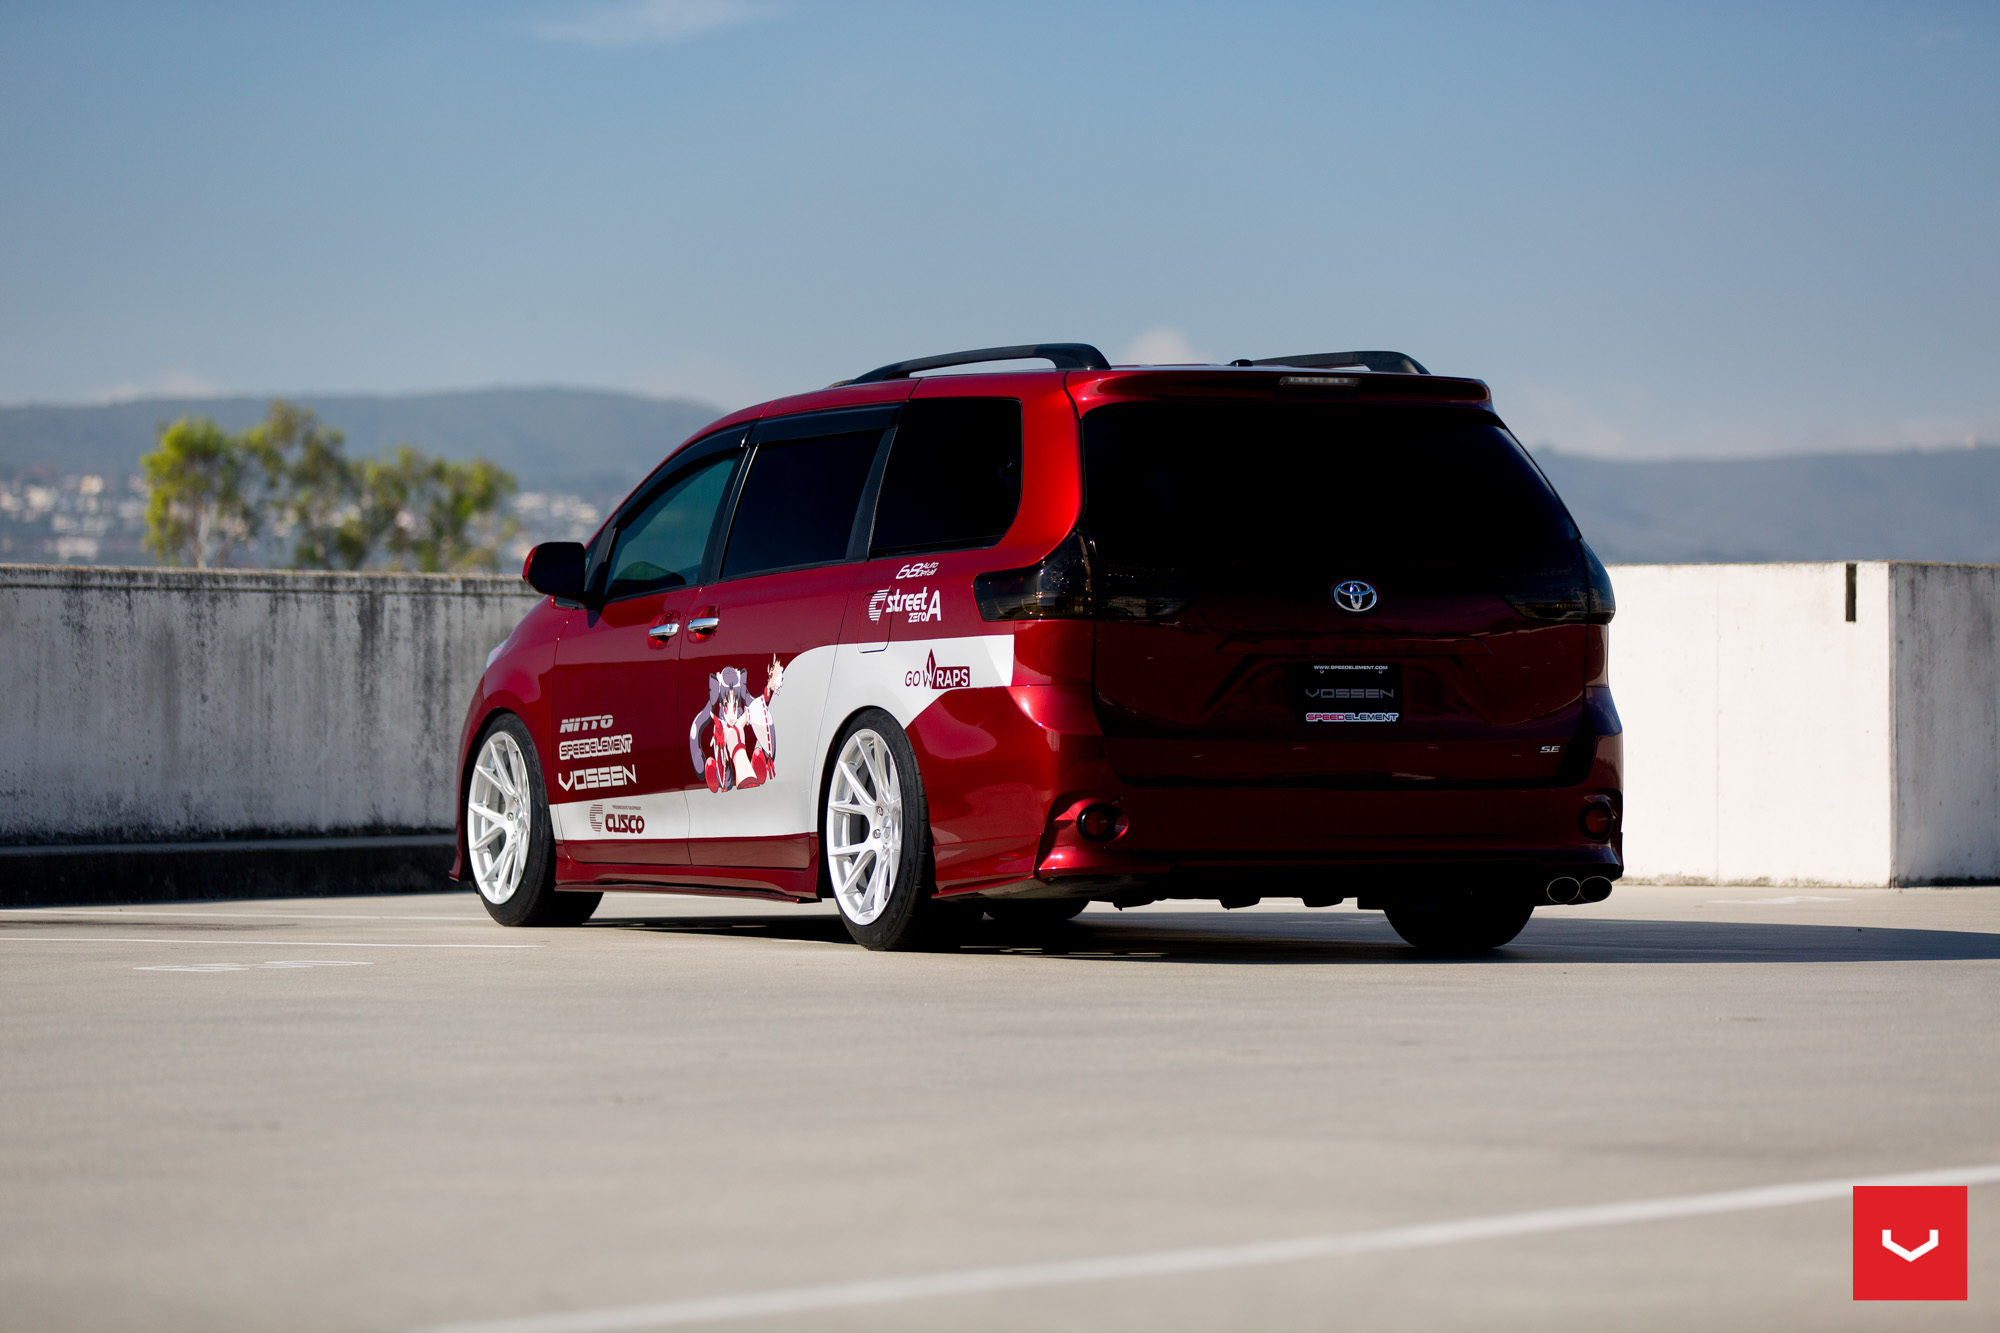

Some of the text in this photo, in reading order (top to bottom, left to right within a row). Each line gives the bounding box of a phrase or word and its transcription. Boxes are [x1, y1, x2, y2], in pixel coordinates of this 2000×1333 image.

[896, 563, 924, 579] 68
[886, 587, 942, 622] street A
[904, 649, 970, 689] GO WRAPS
[1305, 689, 1394, 699] VOSSEN
[560, 715, 613, 733] NITTO
[1306, 713, 1399, 722] SPEEDELEMENT
[559, 734, 633, 760] SPEEDELEMENT
[558, 764, 637, 791] VOSSEN
[605, 814, 645, 834] CUSCO
